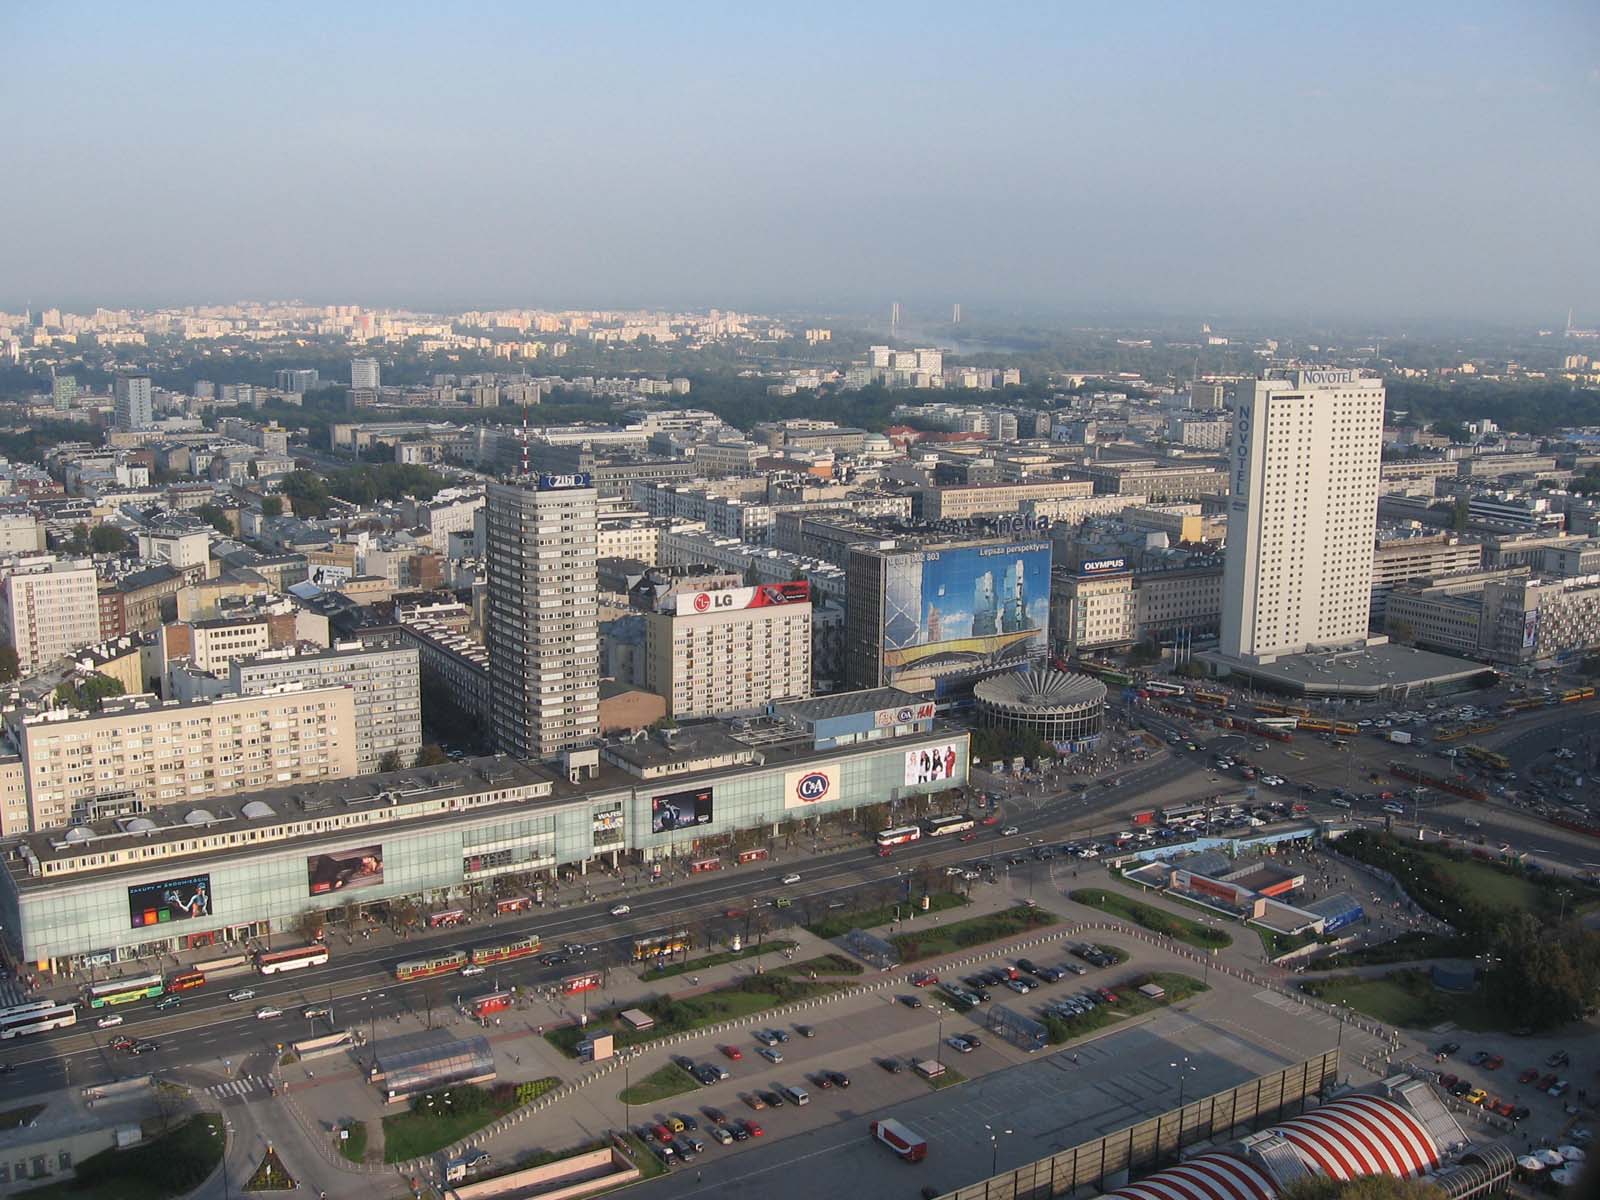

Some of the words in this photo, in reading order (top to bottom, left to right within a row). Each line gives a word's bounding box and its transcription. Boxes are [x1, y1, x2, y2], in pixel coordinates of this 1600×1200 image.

[1236, 406, 1250, 495] NOVOTEL
[1084, 559, 1124, 570] OLYMPUS
[715, 594, 733, 607] LG
[802, 779, 824, 795] C&A
